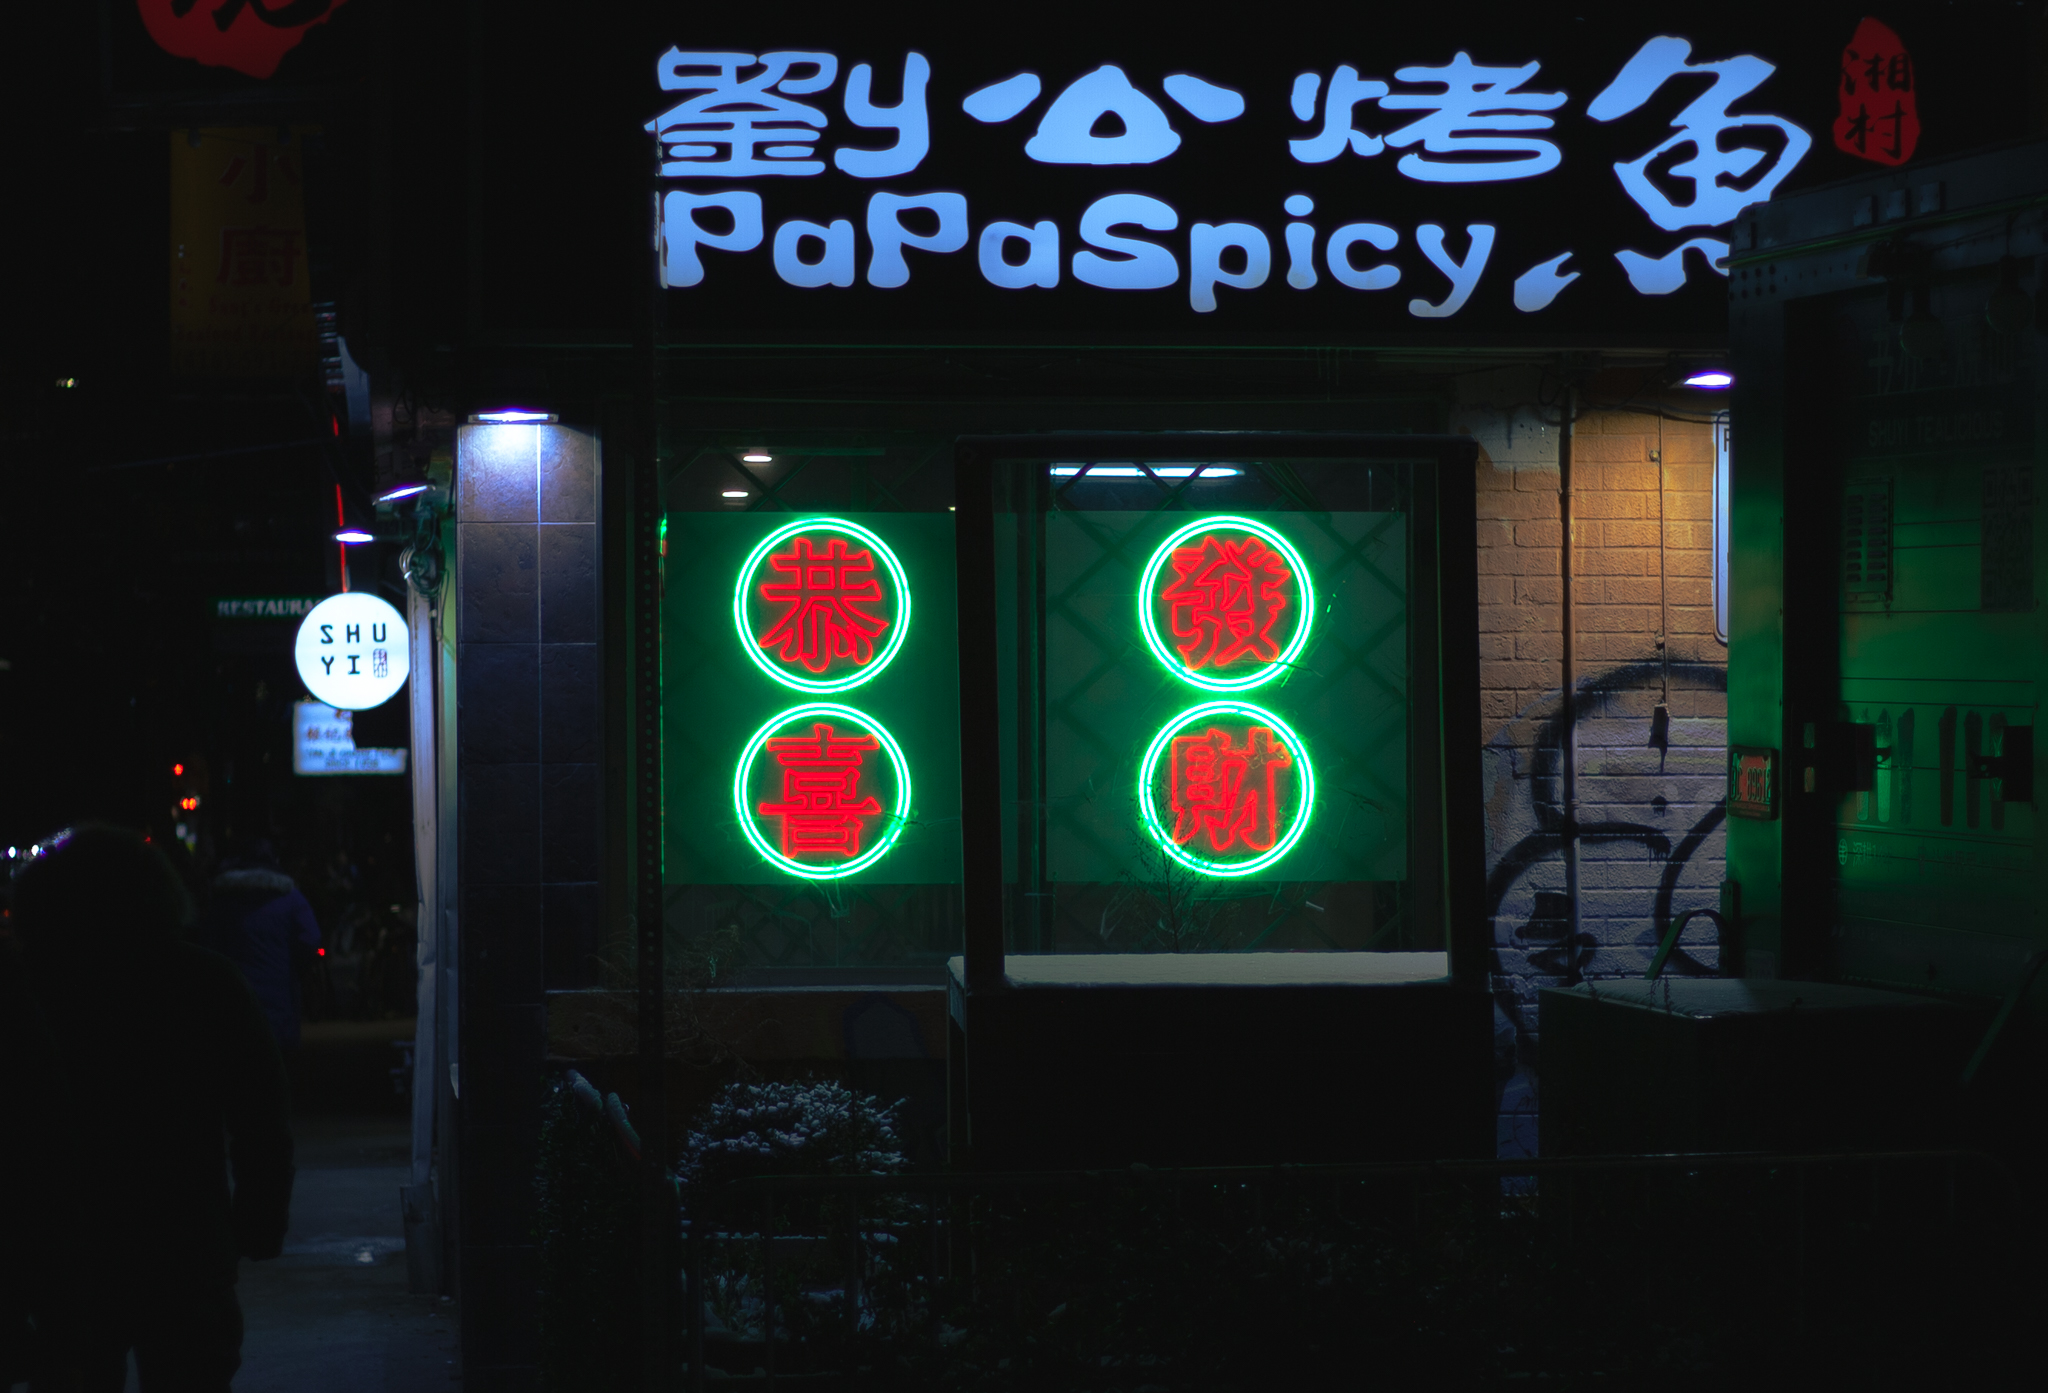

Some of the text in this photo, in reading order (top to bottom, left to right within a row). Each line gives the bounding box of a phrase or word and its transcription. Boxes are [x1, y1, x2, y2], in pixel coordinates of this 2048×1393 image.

[1842, 49, 1911, 160] 湘村
[652, 190, 1496, 317] PaPaSpicy
[1868, 410, 2004, 448] SHUYI TEALICIOUS
[319, 622, 387, 644] SHU
[320, 654, 361, 676] YI
[759, 537, 889, 859] 恭喜
[1162, 536, 1292, 852] 發財
